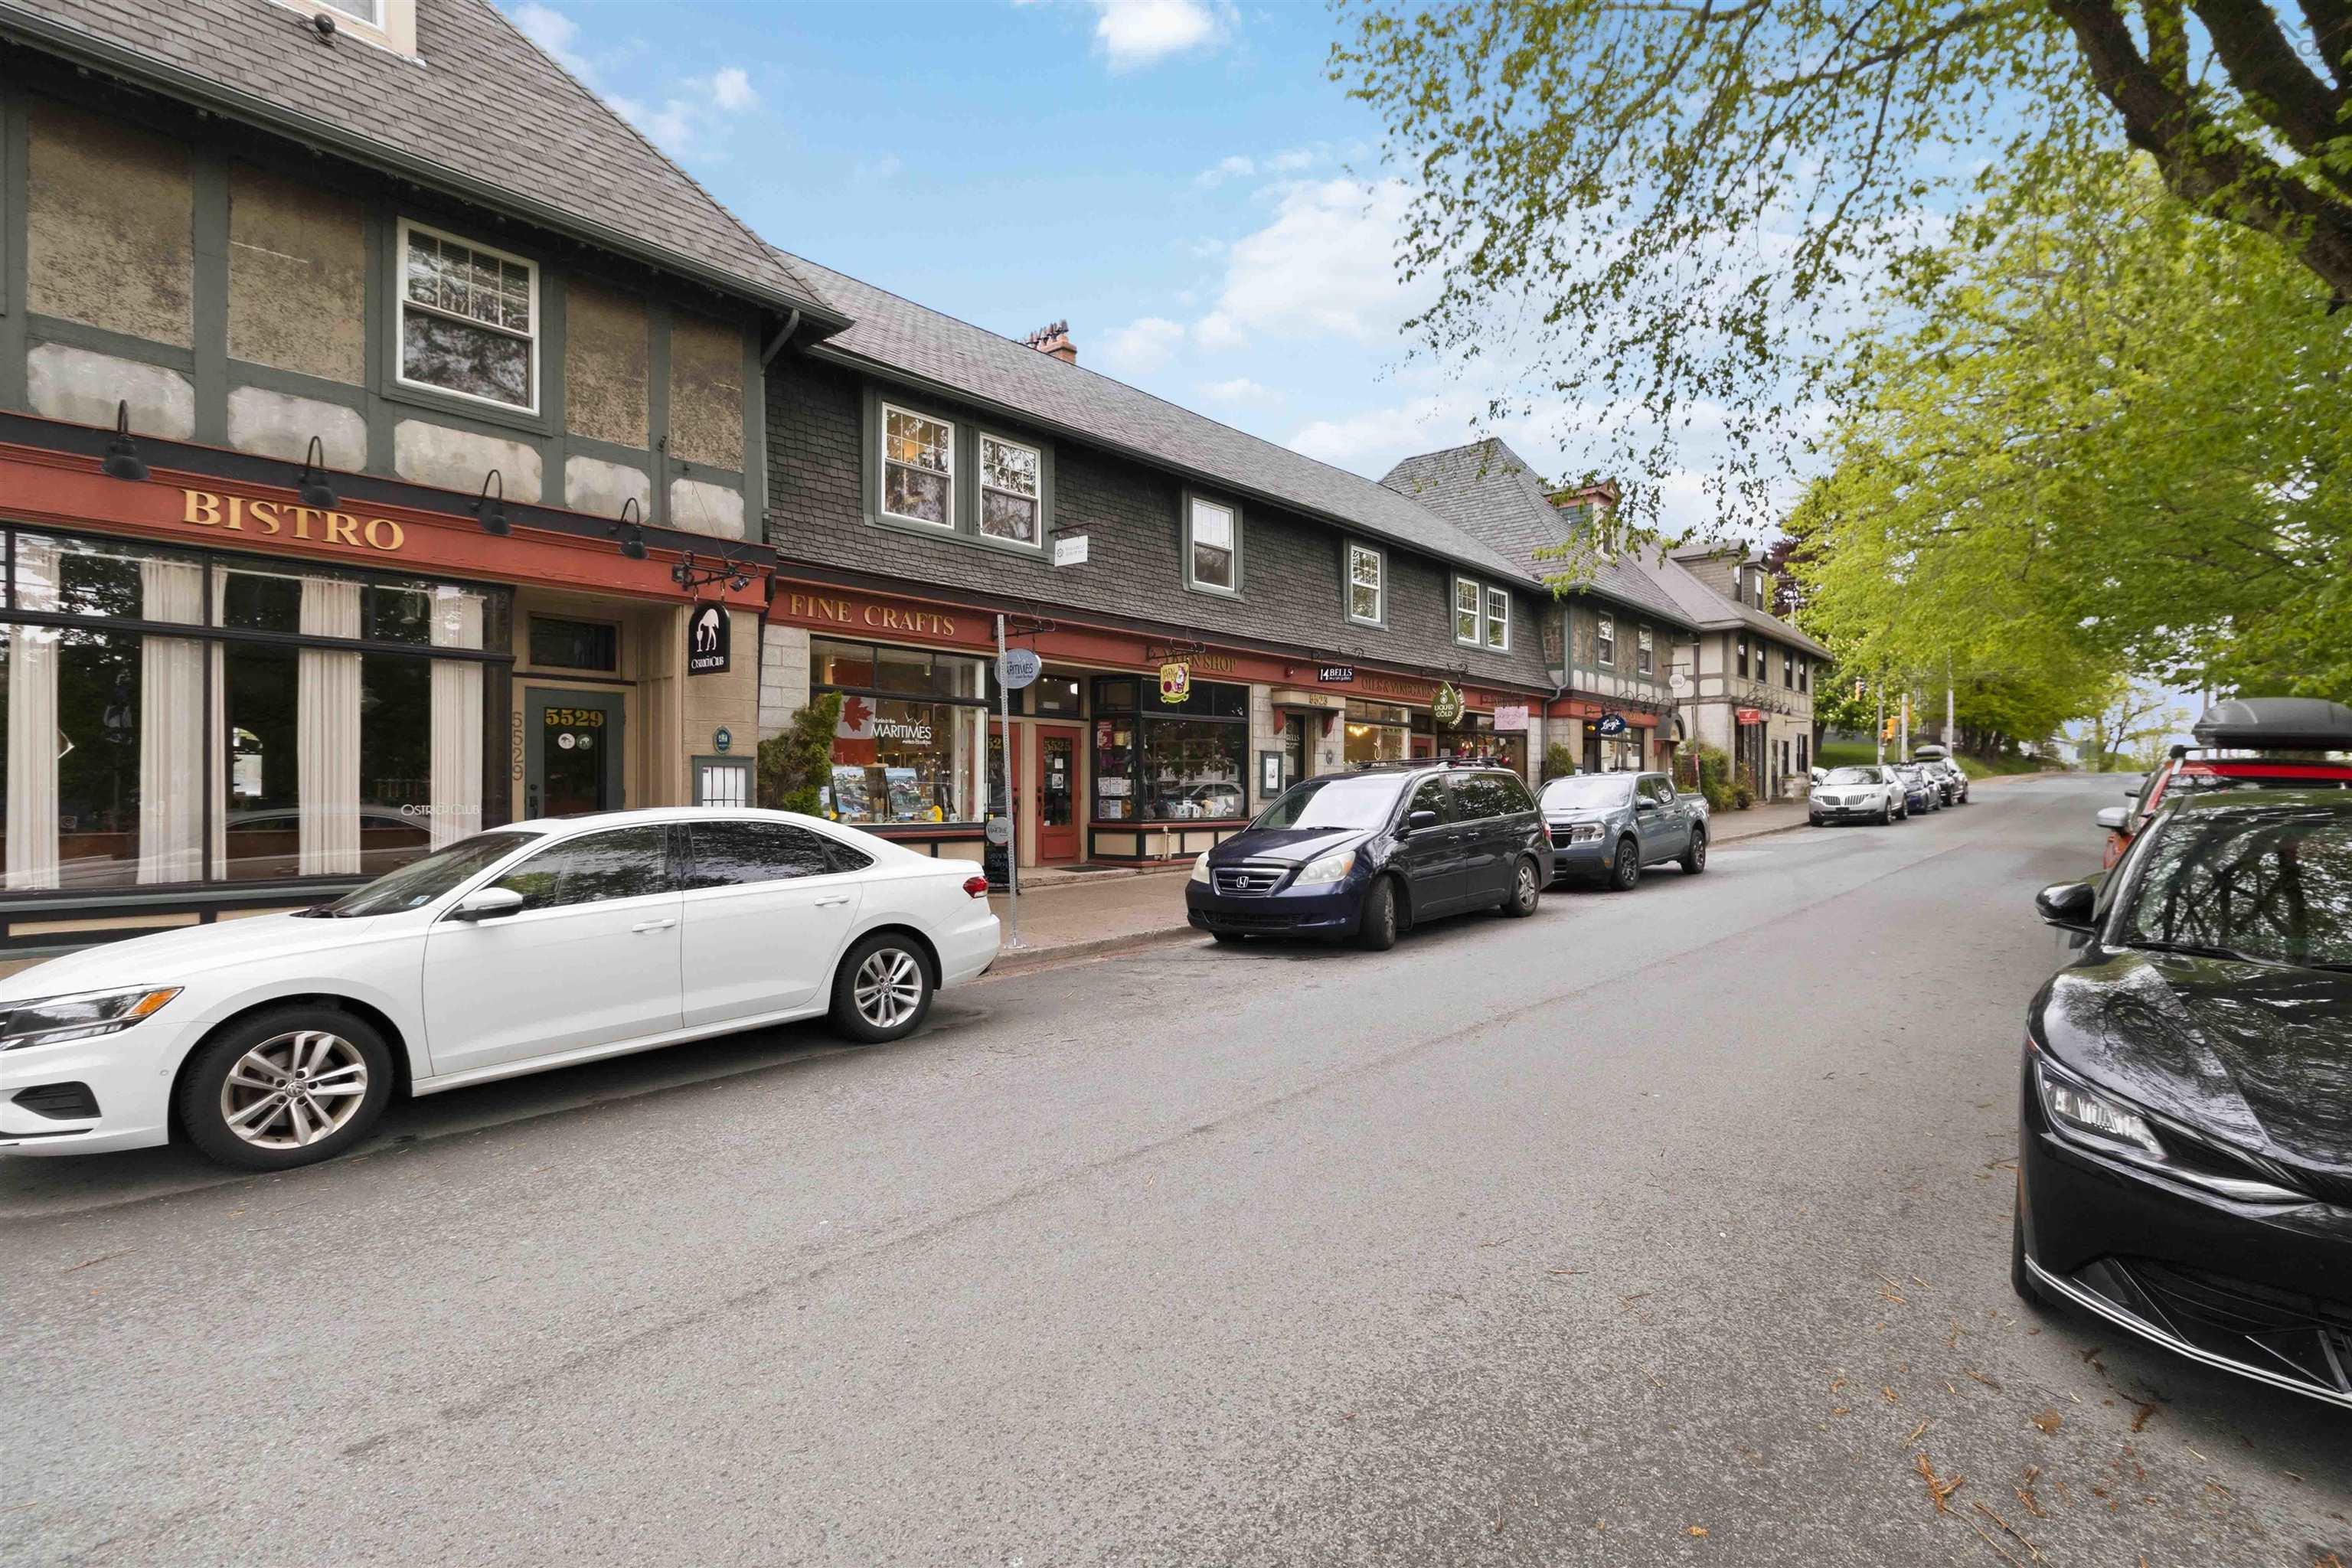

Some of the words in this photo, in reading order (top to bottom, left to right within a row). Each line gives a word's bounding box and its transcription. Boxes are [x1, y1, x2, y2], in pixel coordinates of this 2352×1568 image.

[181, 488, 405, 550] BISTRO
[790, 592, 853, 623] FINE
[864, 605, 956, 637] CRAFTS
[998, 662, 1034, 674] ARITIMES
[1203, 655, 1237, 672] SHOP
[1320, 668, 1329, 681] 14
[1330, 668, 1352, 677] BELLS
[545, 708, 603, 727] 5529
[871, 724, 932, 740] MARITIMES
[512, 711, 524, 781] 5529
